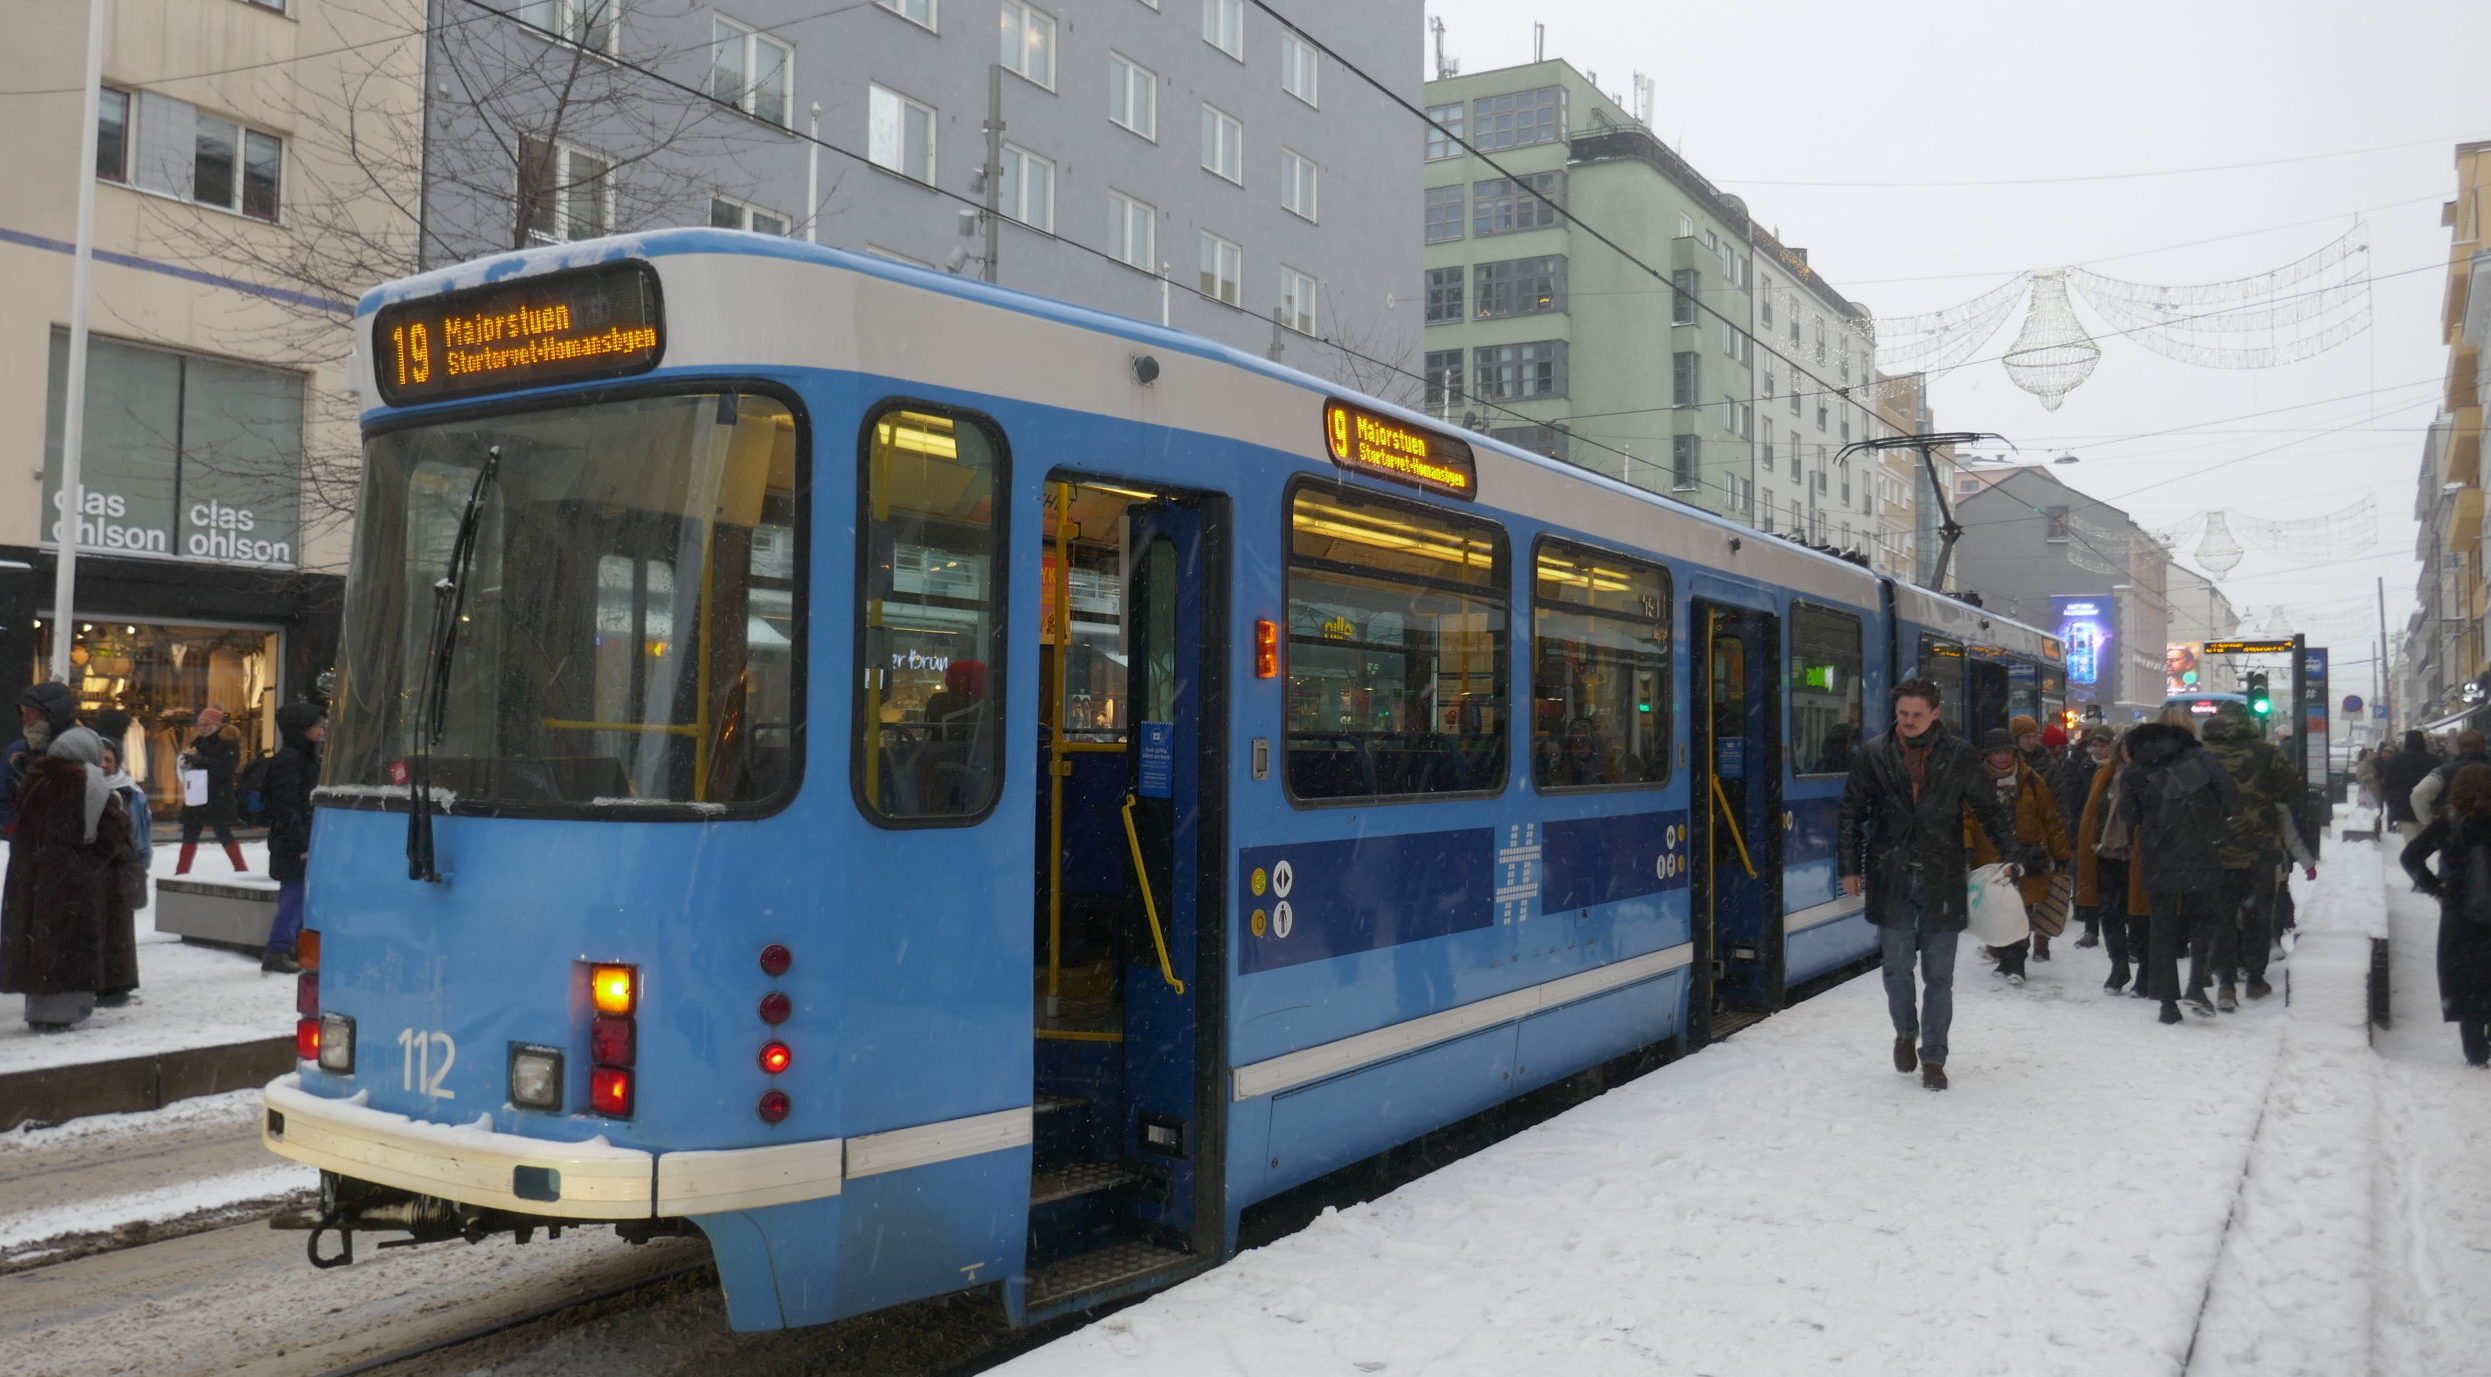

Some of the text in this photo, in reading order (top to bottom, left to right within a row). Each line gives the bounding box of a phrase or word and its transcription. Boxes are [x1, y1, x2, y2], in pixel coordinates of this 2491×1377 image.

[394, 304, 569, 385] 19 Majorstuen
[1357, 415, 1425, 456] Majorstuen
[190, 499, 255, 531] clas
[189, 529, 290, 562] ohlson
[398, 1028, 456, 1100] 112
